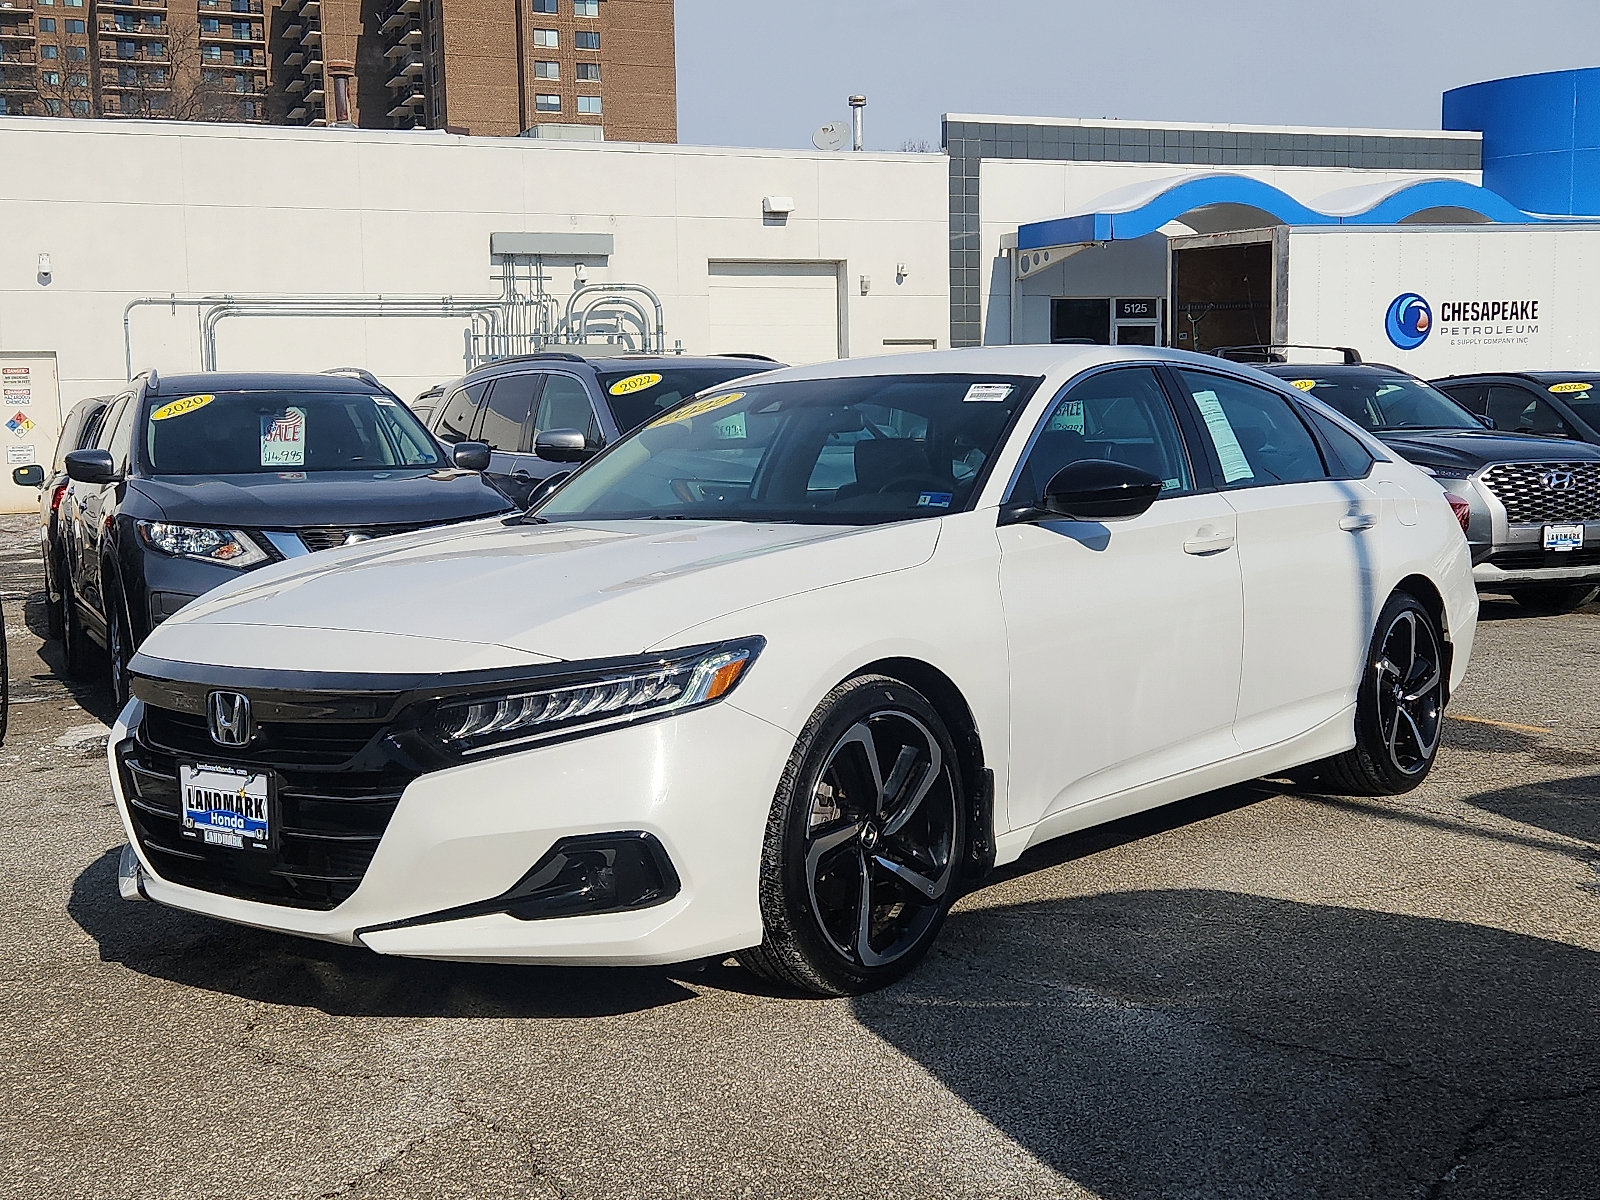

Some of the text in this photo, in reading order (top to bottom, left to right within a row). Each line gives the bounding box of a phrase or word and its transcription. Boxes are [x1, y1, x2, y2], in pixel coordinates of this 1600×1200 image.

[1123, 303, 1148, 314] 5125
[1441, 300, 1539, 322] CHESAPEAKE
[1440, 325, 1539, 336] PETROLEUM
[1483, 337, 1515, 345] COMPANY
[619, 374, 655, 393] 2022
[163, 396, 203, 417] 2020
[9, 419, 16, 429] 2
[16, 413, 22, 422] 4
[25, 420, 29, 429] 1
[264, 423, 301, 443] SALE
[1547, 532, 1581, 541] LANDMARK
[187, 787, 265, 820] LANDMARK
[210, 812, 245, 829] Honda
[204, 829, 245, 849] LANDMARK
